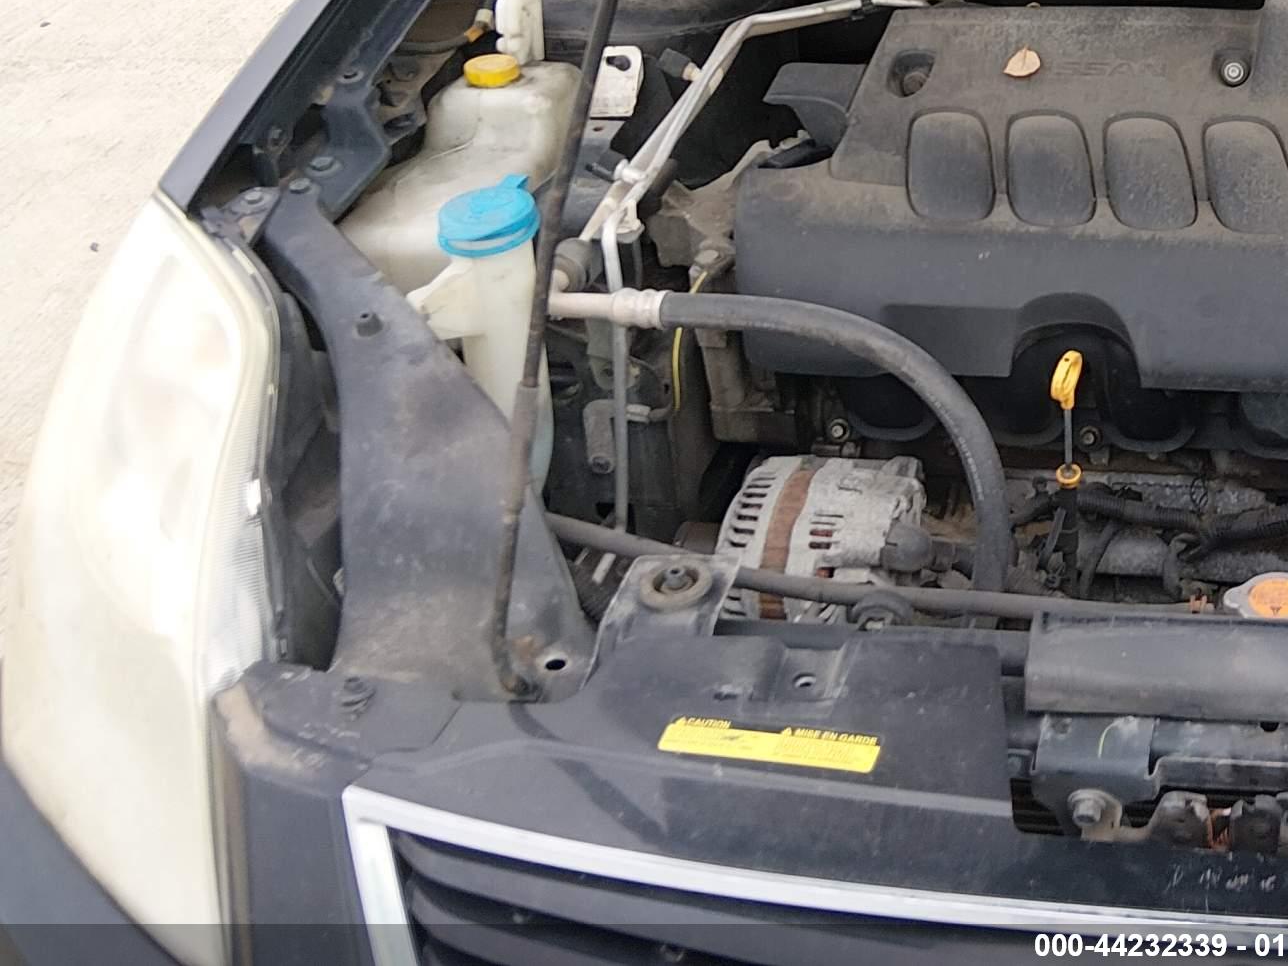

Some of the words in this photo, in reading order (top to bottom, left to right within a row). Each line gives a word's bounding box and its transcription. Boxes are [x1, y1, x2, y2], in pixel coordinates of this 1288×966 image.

[686, 716, 732, 730] CAUTION
[794, 727, 821, 740] MISE
[821, 731, 839, 742] EN
[839, 733, 878, 746] GARDE
